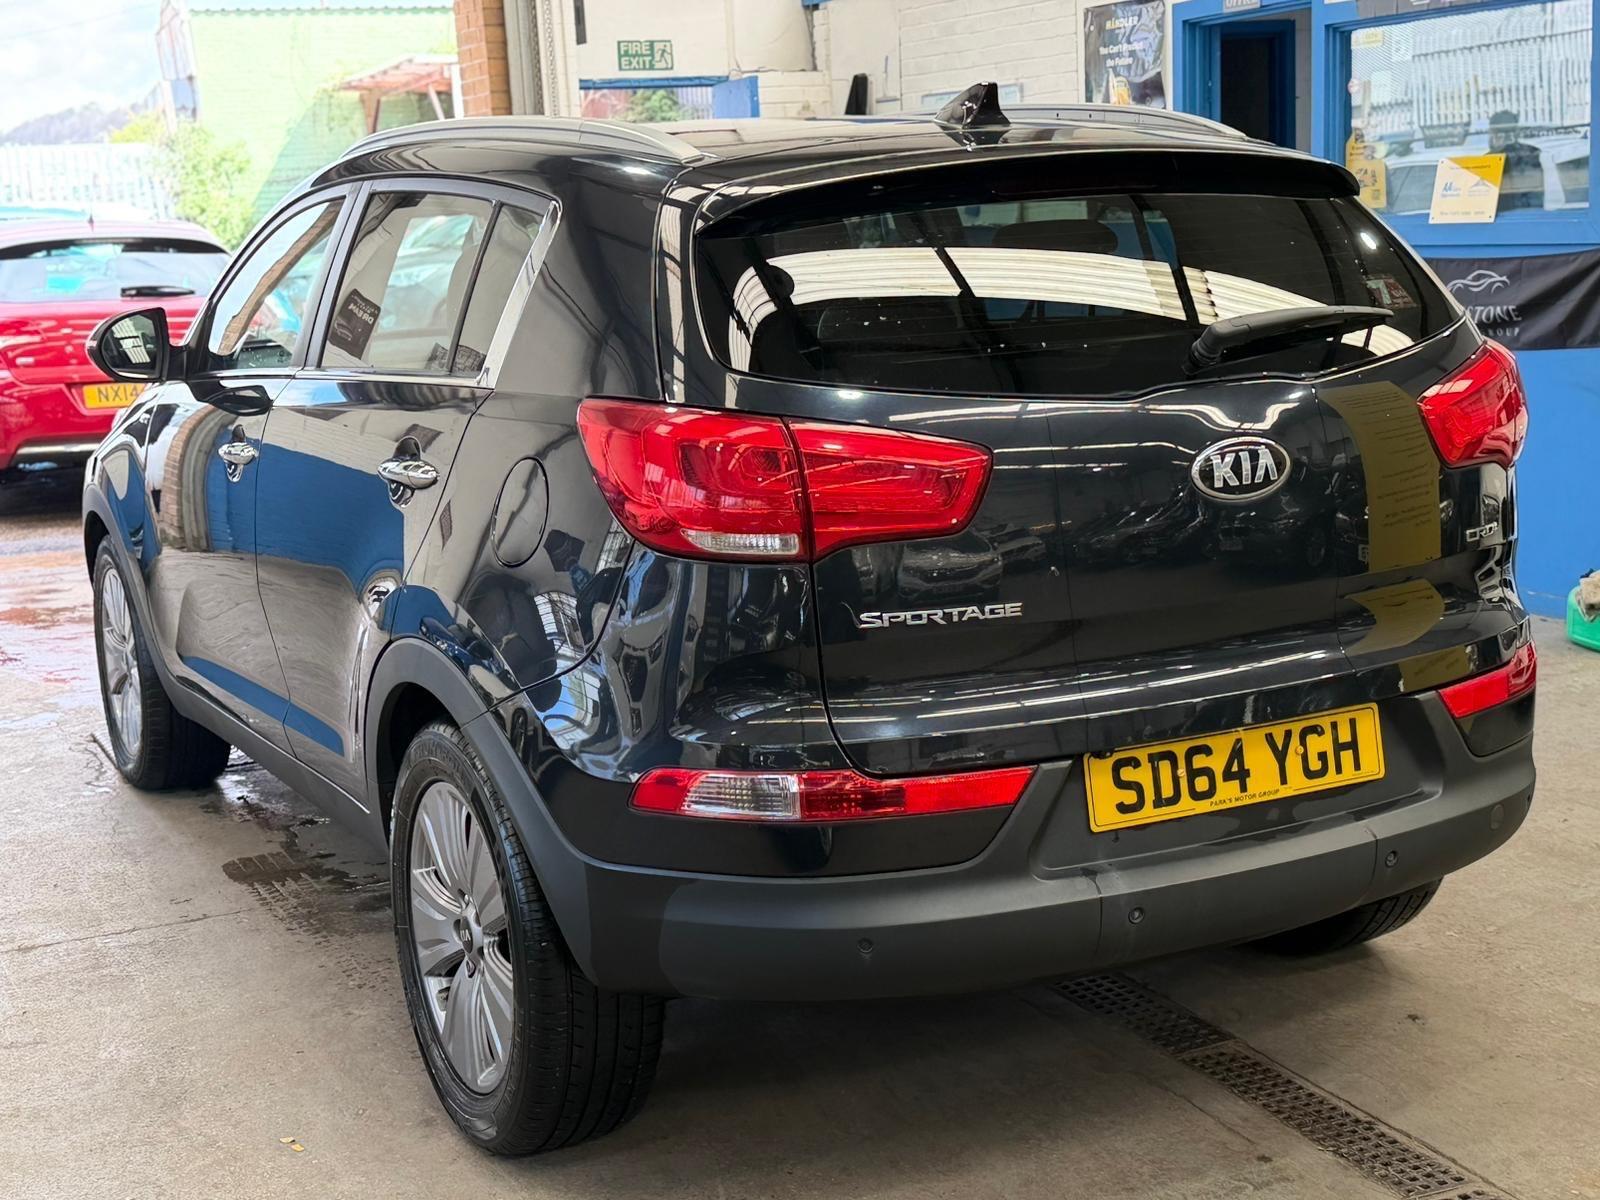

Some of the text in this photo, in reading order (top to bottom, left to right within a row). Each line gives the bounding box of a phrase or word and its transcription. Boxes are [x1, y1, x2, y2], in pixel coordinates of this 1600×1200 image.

[620, 42, 651, 55] FIRE
[621, 56, 652, 69] EXIT
[1210, 447, 1279, 489] KIA
[859, 602, 1023, 629] SPORTAGE
[1111, 717, 1361, 815] SD64 YGH
[1234, 792, 1257, 802] MOTOR
[1258, 788, 1280, 798] GROUP
